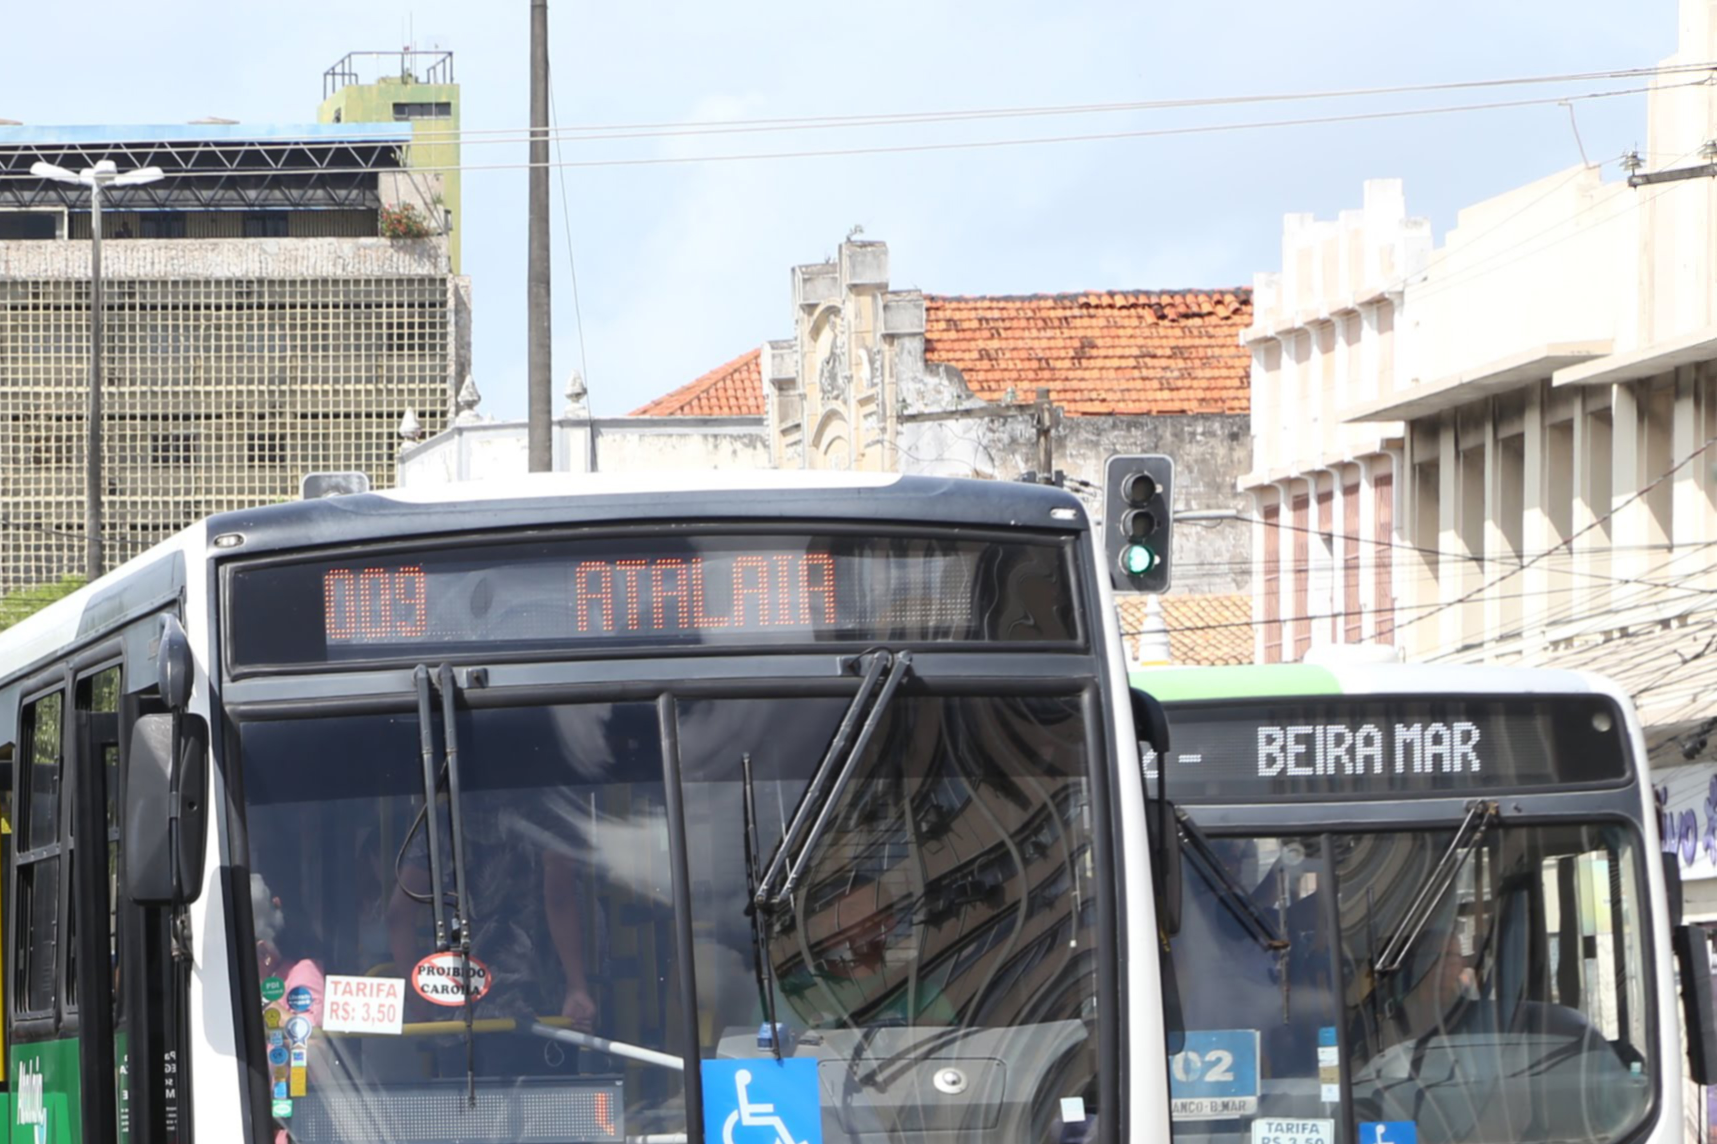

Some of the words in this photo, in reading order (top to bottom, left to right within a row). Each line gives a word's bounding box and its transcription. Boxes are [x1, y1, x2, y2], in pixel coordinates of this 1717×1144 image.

[324, 567, 426, 638] 009
[575, 552, 836, 632] ATALAIA
[1258, 724, 1382, 776] BEIRA
[1395, 722, 1480, 773] MAR
[331, 980, 398, 999] TARIFA
[361, 1004, 396, 1025] 3,50
[1266, 1121, 1320, 1135] TARIFA
